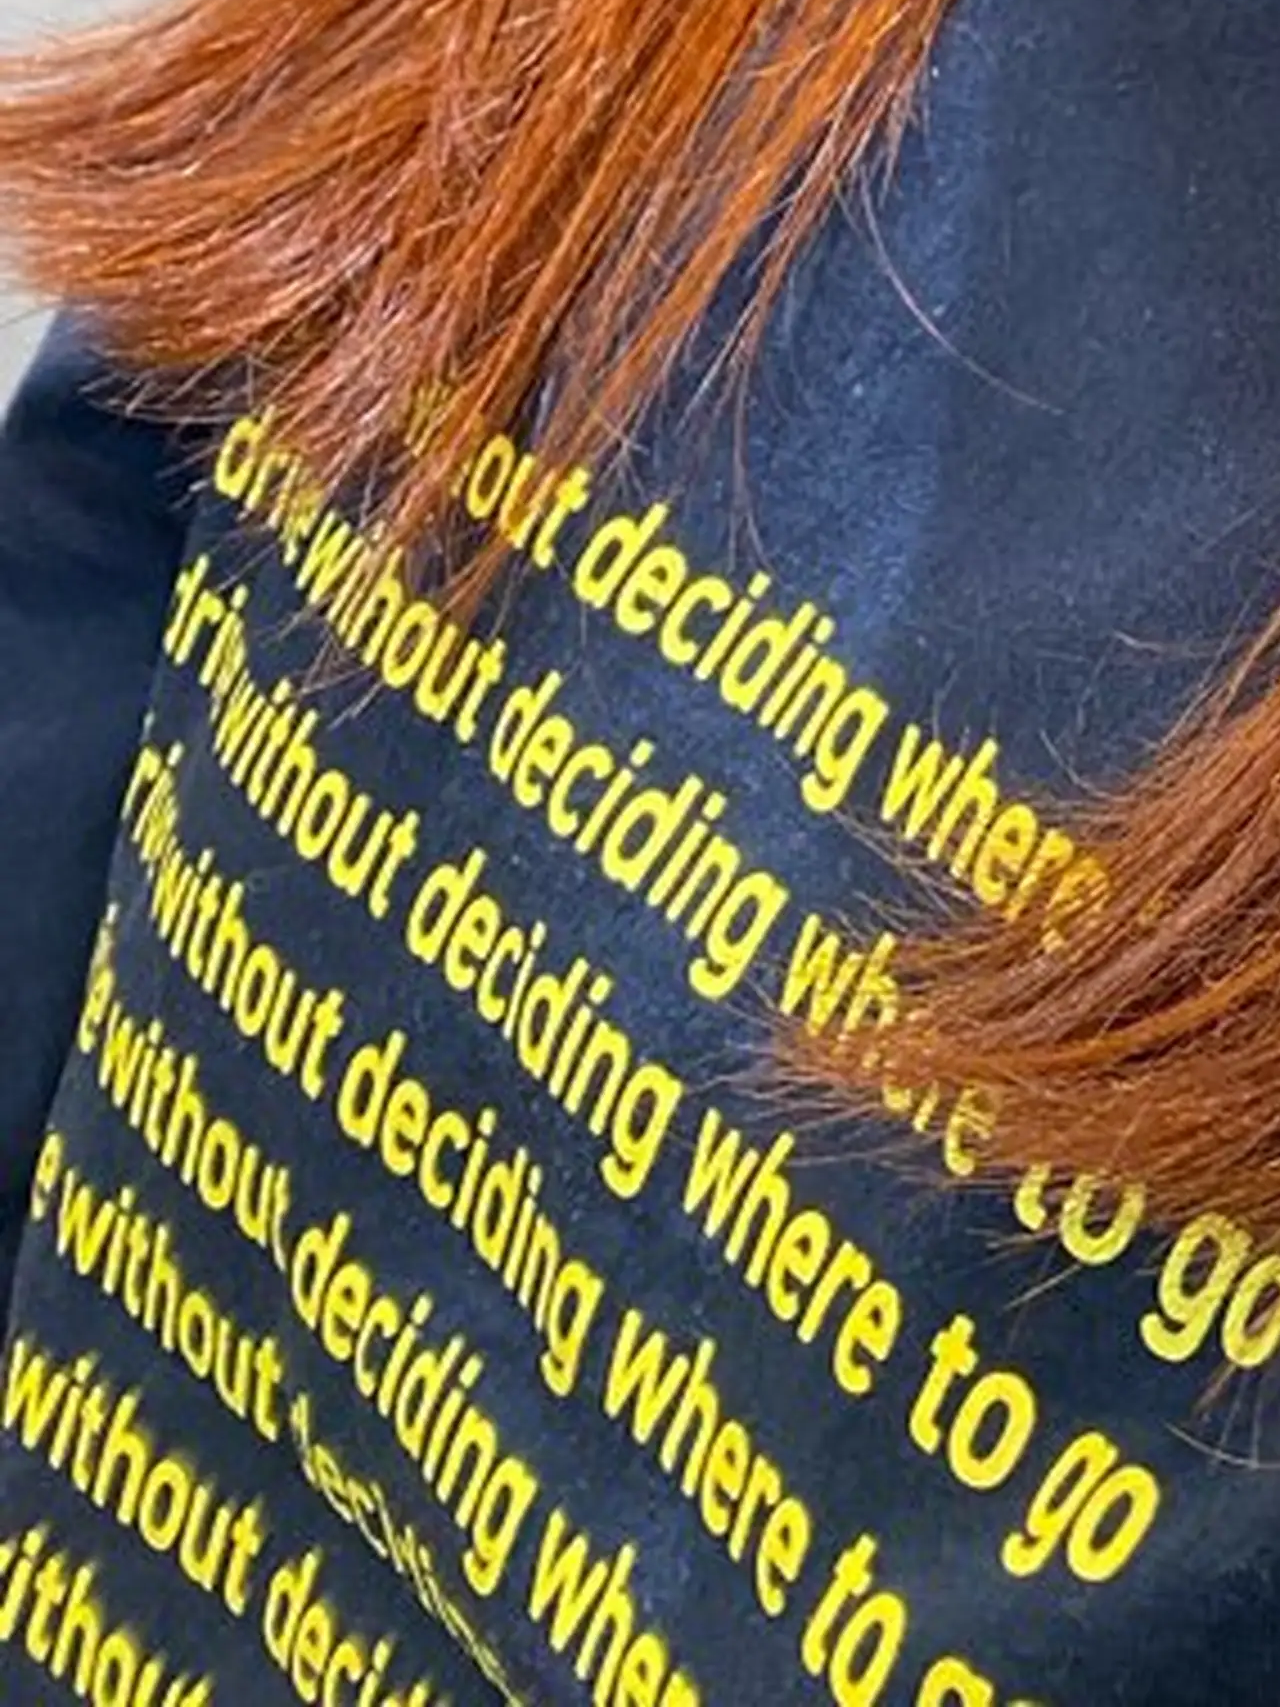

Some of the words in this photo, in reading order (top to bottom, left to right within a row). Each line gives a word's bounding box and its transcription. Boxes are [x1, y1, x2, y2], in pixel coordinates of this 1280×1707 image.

[574, 501, 889, 812] deciding
[490, 670, 789, 999] deciding
[151, 838, 343, 1101] without
[338, 1030, 603, 1397] deciding
[602, 1308, 812, 1617] where
[802, 1533, 908, 1707] to
[213, 669, 419, 919] without
[406, 848, 684, 1200] deciding
[684, 1107, 901, 1394] where
[909, 1314, 1036, 1490] to
[1000, 1430, 1161, 1581] go
[57, 1167, 283, 1442] without
[292, 1212, 538, 1595] deciding
[3, 1337, 265, 1617] without
